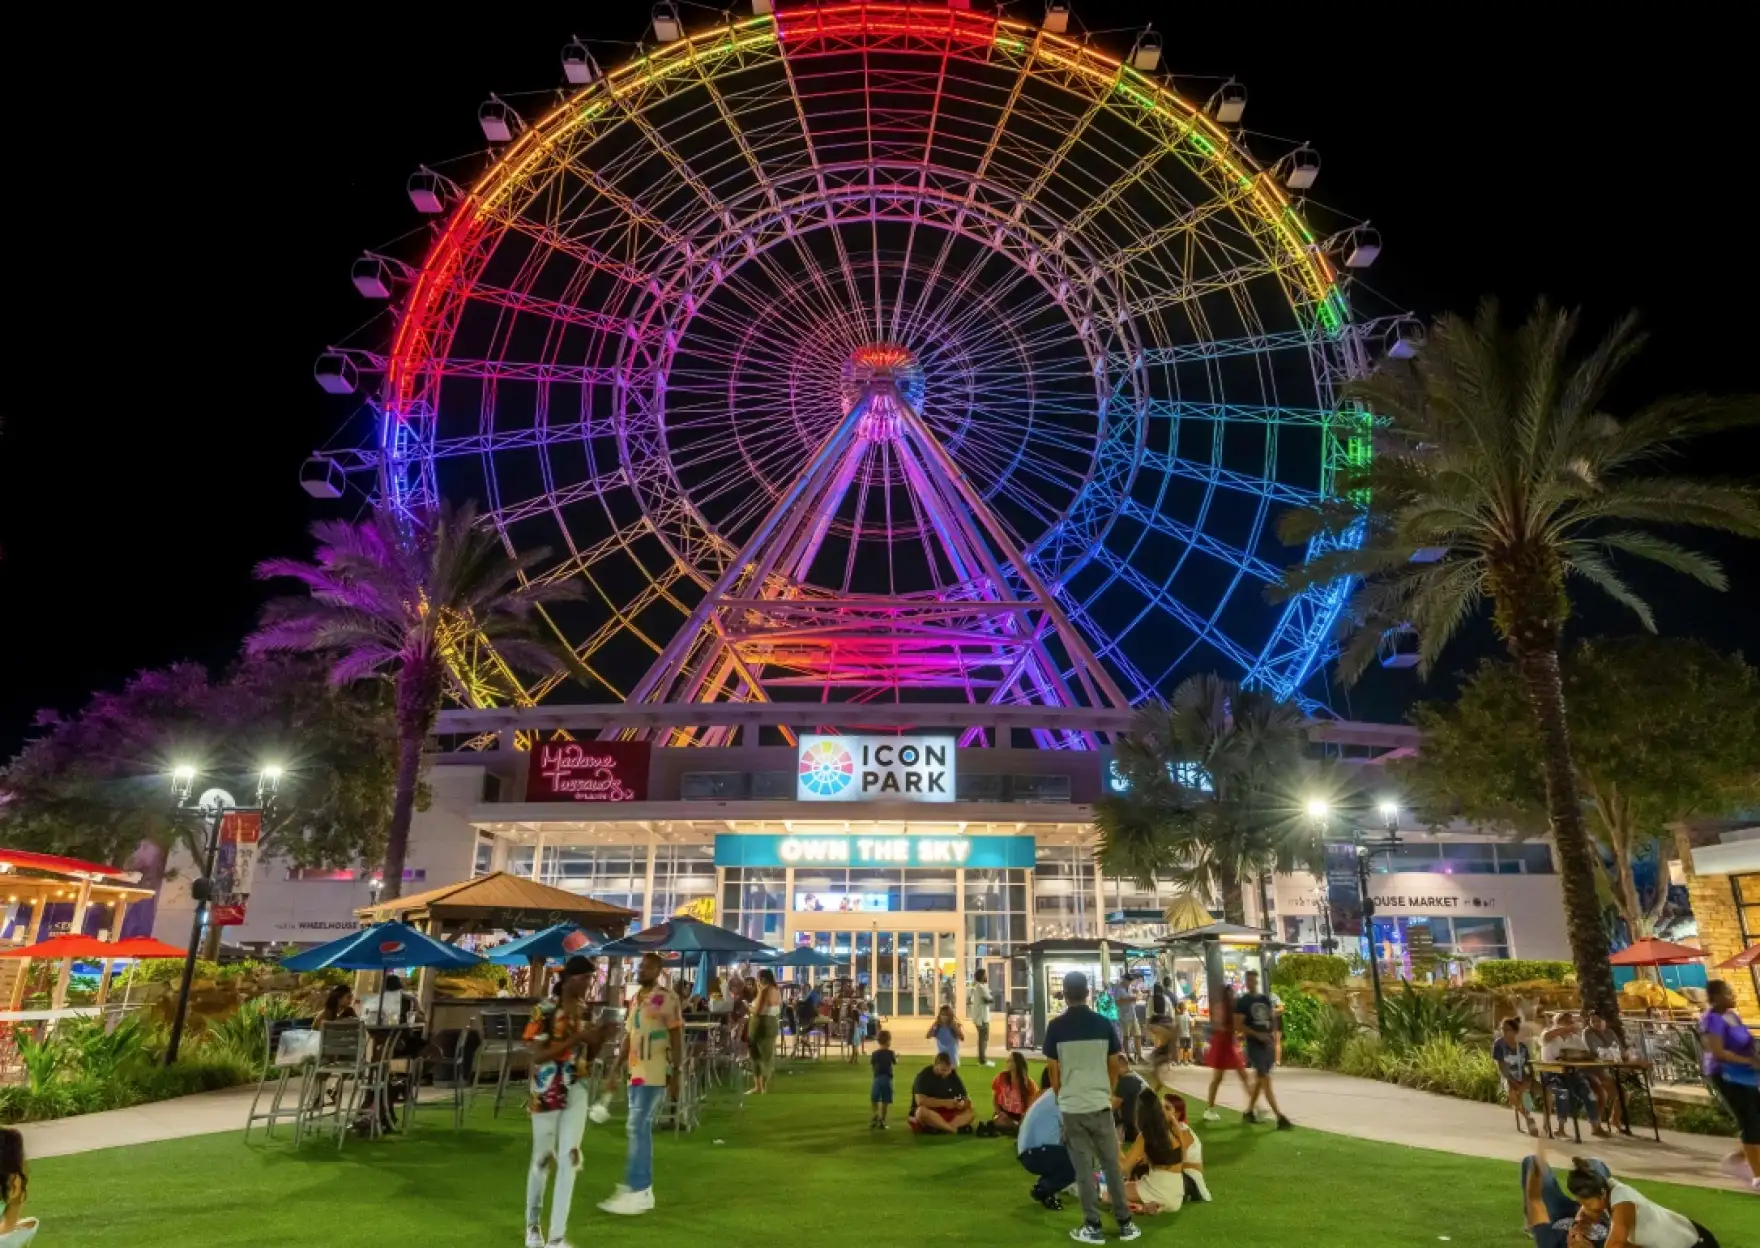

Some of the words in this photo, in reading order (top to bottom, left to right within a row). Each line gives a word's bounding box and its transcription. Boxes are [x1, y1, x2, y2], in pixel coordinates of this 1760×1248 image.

[541, 744, 617, 769] Madame
[862, 744, 946, 767] ICON
[541, 768, 635, 802] Tussauds
[861, 771, 946, 793] PARK
[780, 838, 848, 862] OWN
[857, 838, 910, 862] THE
[917, 838, 970, 862] SKY
[1409, 896, 1459, 907] MARKET
[299, 921, 358, 930] WHEELHOUSE
